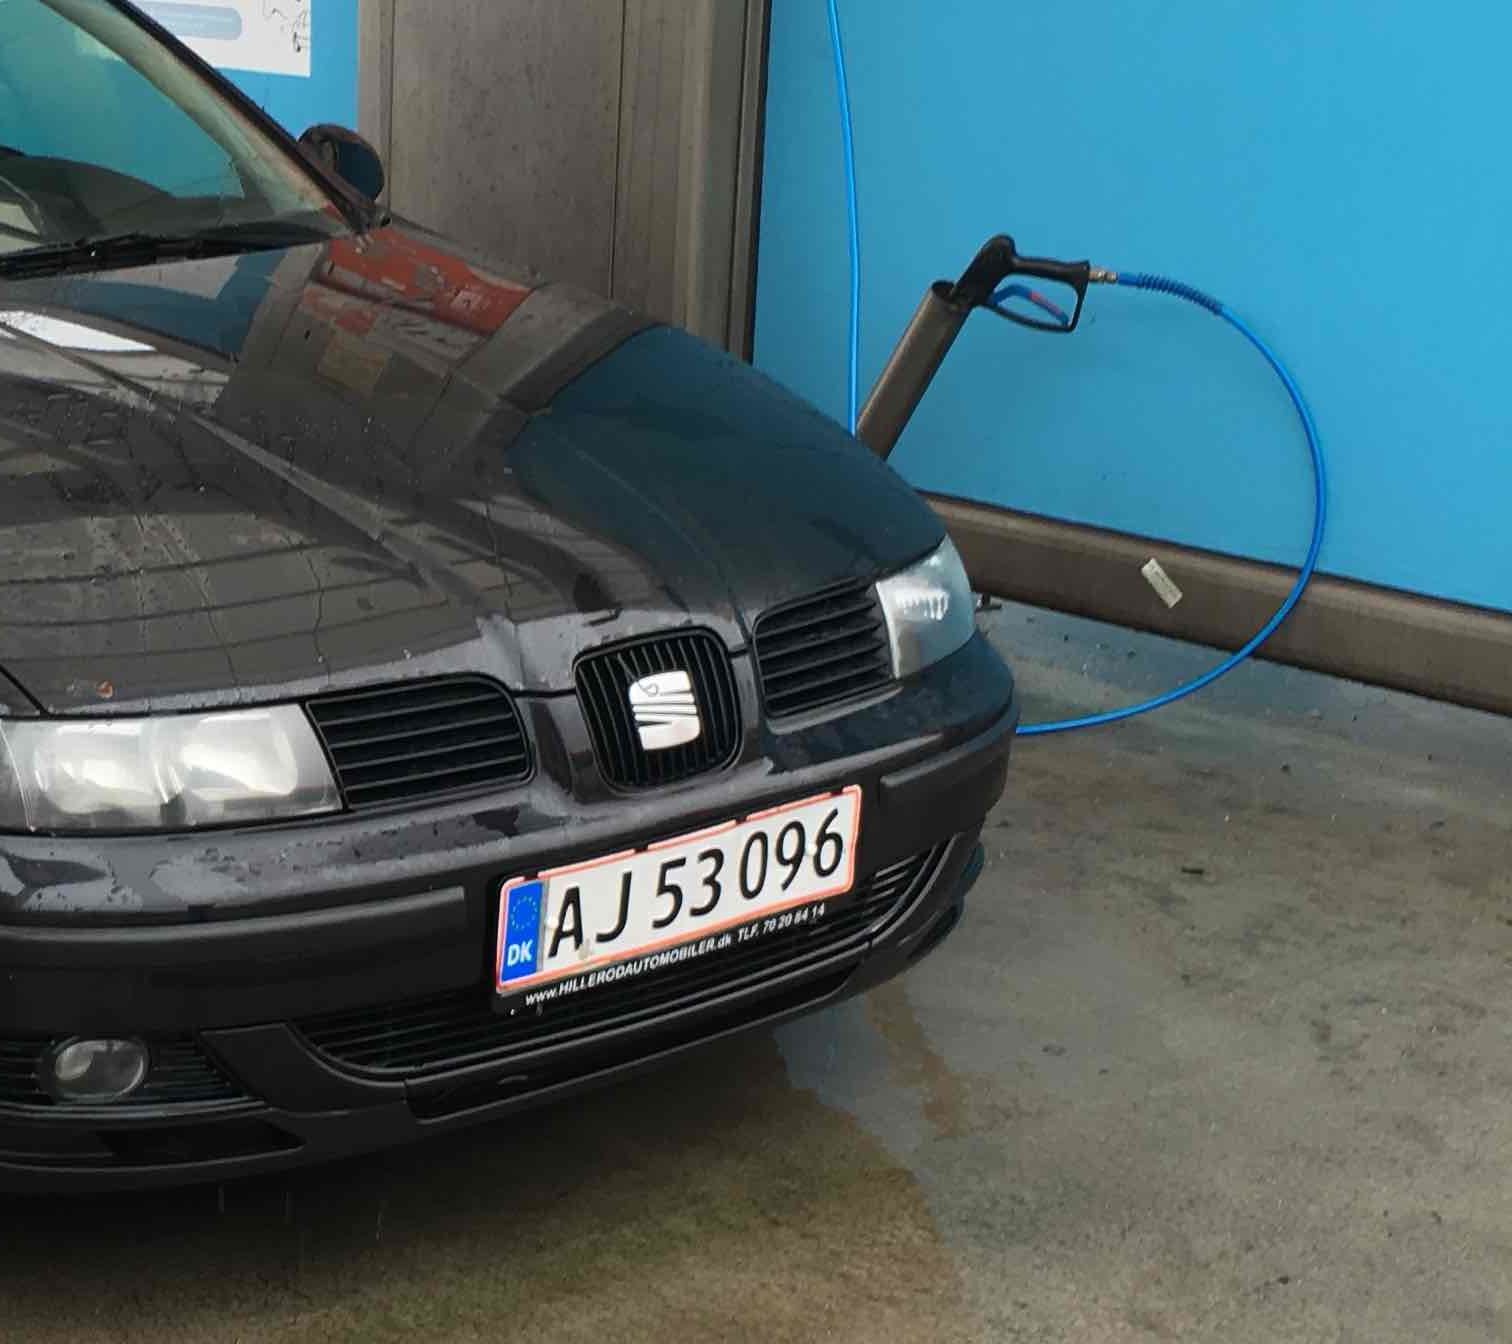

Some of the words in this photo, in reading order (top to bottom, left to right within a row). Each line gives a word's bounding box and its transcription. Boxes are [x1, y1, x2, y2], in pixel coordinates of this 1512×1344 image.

[548, 871, 633, 958] AJ
[652, 848, 725, 929] 53
[739, 808, 844, 901] 096
[811, 902, 825, 918] 14
[507, 939, 533, 967] DK
